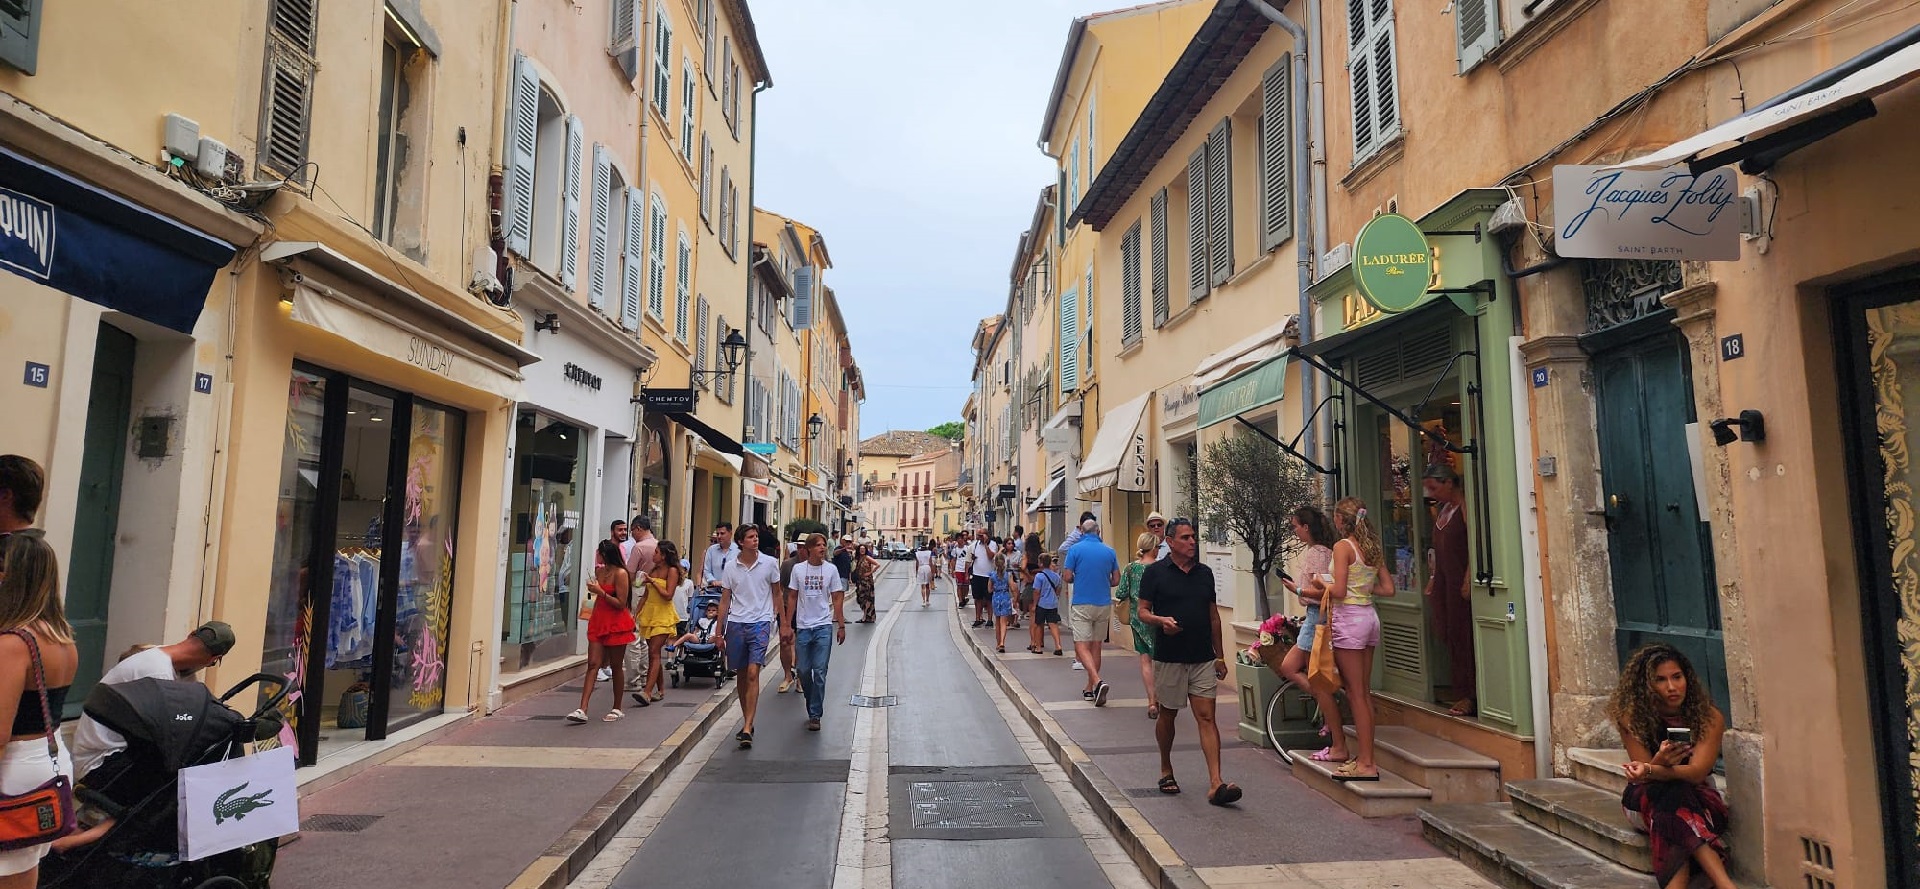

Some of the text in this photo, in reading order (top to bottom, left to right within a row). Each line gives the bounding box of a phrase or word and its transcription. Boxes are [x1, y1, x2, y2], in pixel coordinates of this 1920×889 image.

[1562, 170, 1669, 239] Jacques
[1617, 245, 1684, 255] SAINT BARTH
[1362, 251, 1426, 266] LADURÉE
[1725, 338, 1740, 356] 18
[407, 336, 455, 376] SUNDAY
[30, 366, 45, 383] 15
[1535, 372, 1545, 383] 20
[199, 377, 209, 390] 17
[1135, 433, 1146, 487] SENSO
[175, 713, 193, 721] Joie
